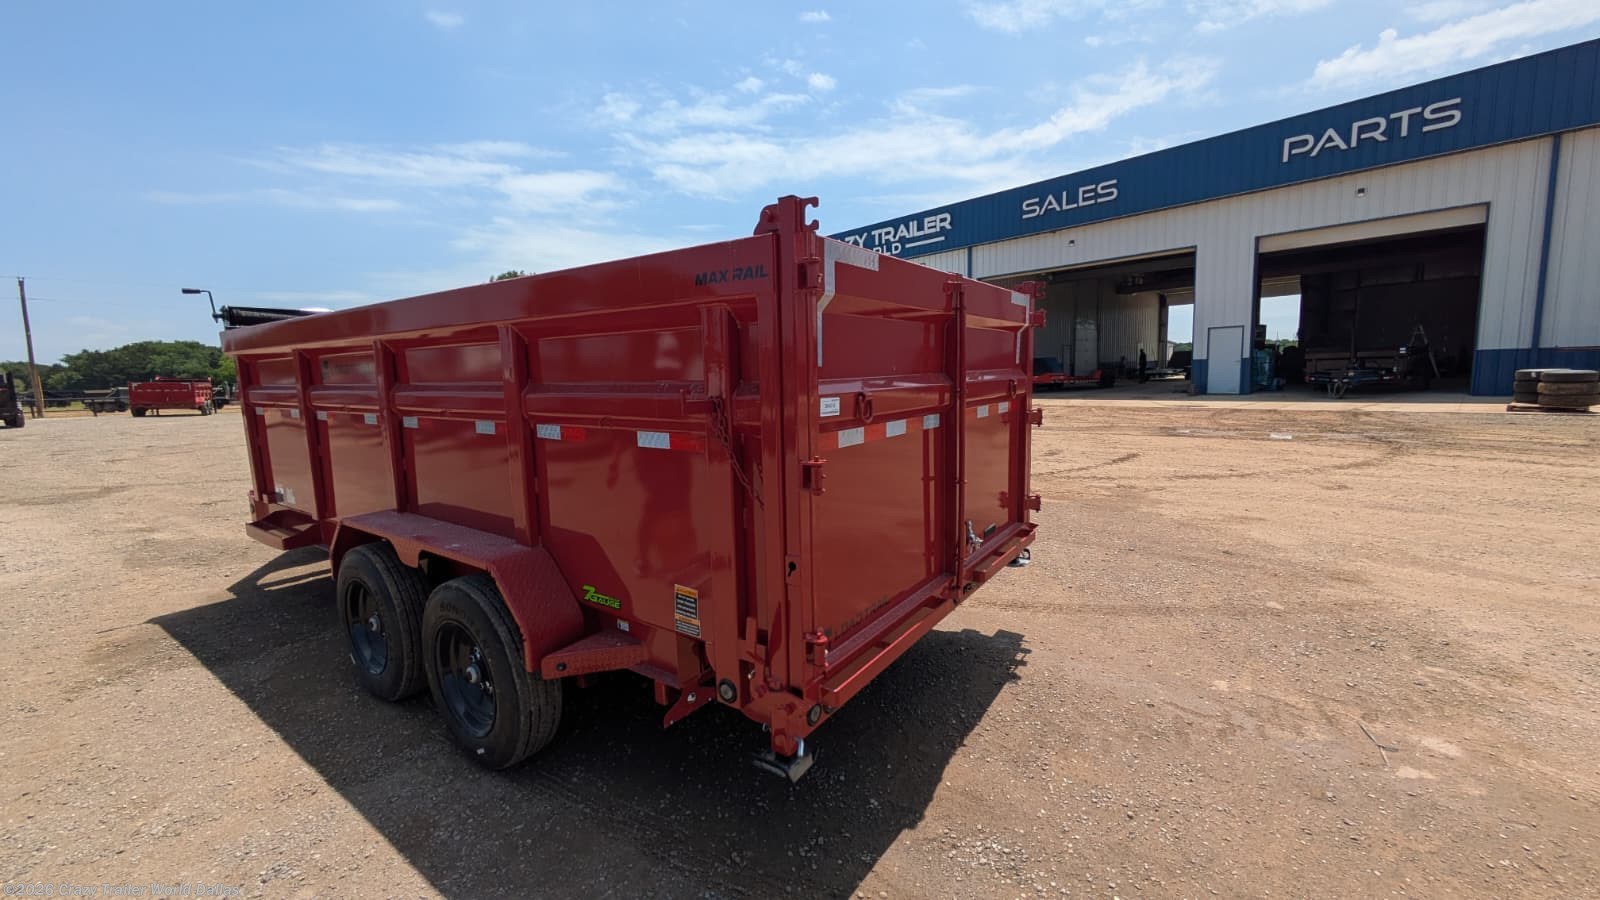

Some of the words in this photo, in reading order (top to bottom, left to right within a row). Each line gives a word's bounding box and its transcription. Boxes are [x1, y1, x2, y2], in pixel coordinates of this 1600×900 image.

[1281, 97, 1462, 163] PARTS
[1022, 179, 1118, 219] SALES
[871, 212, 952, 246] TRAILER
[695, 270, 728, 286] MAX
[732, 264, 768, 281] RAIL
[582, 584, 596, 600] 7
